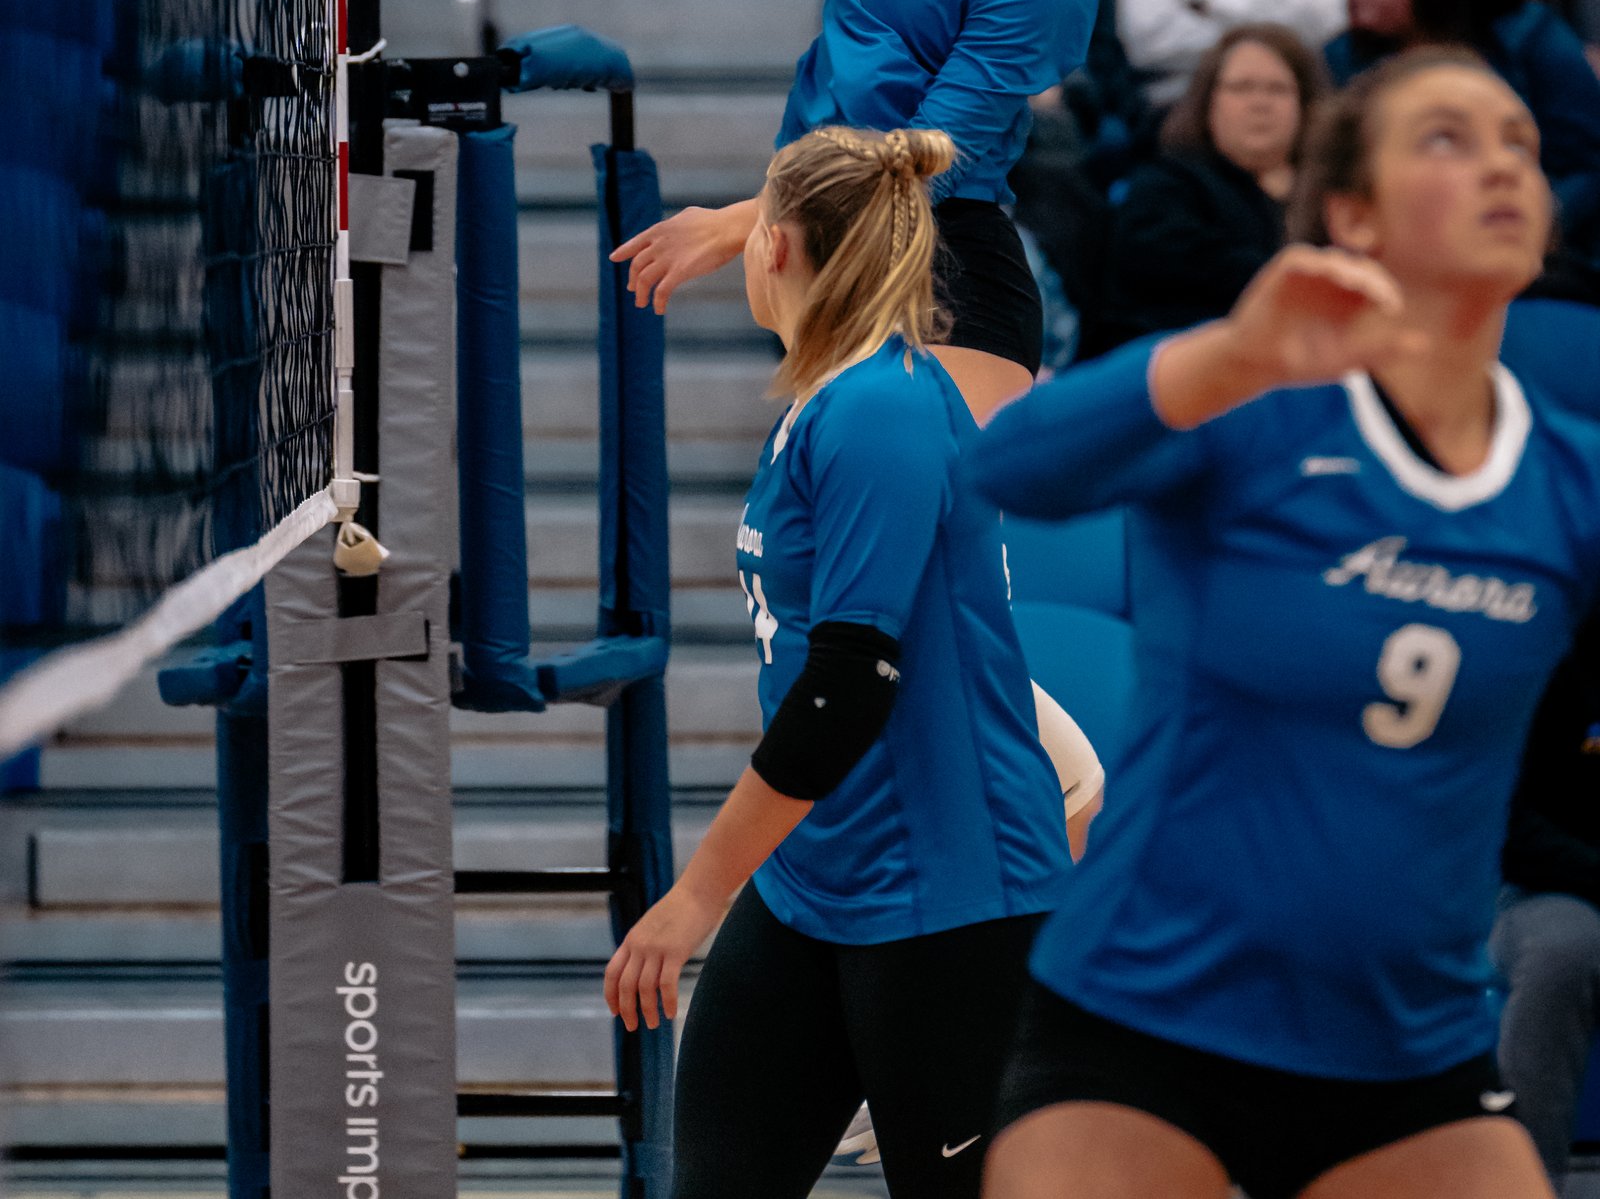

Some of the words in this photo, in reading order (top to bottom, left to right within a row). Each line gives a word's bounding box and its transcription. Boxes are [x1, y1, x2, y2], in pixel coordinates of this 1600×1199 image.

[1322, 535, 1538, 624] Aurora
[1361, 622, 1462, 749] 9
[336, 961, 385, 1108] sports
